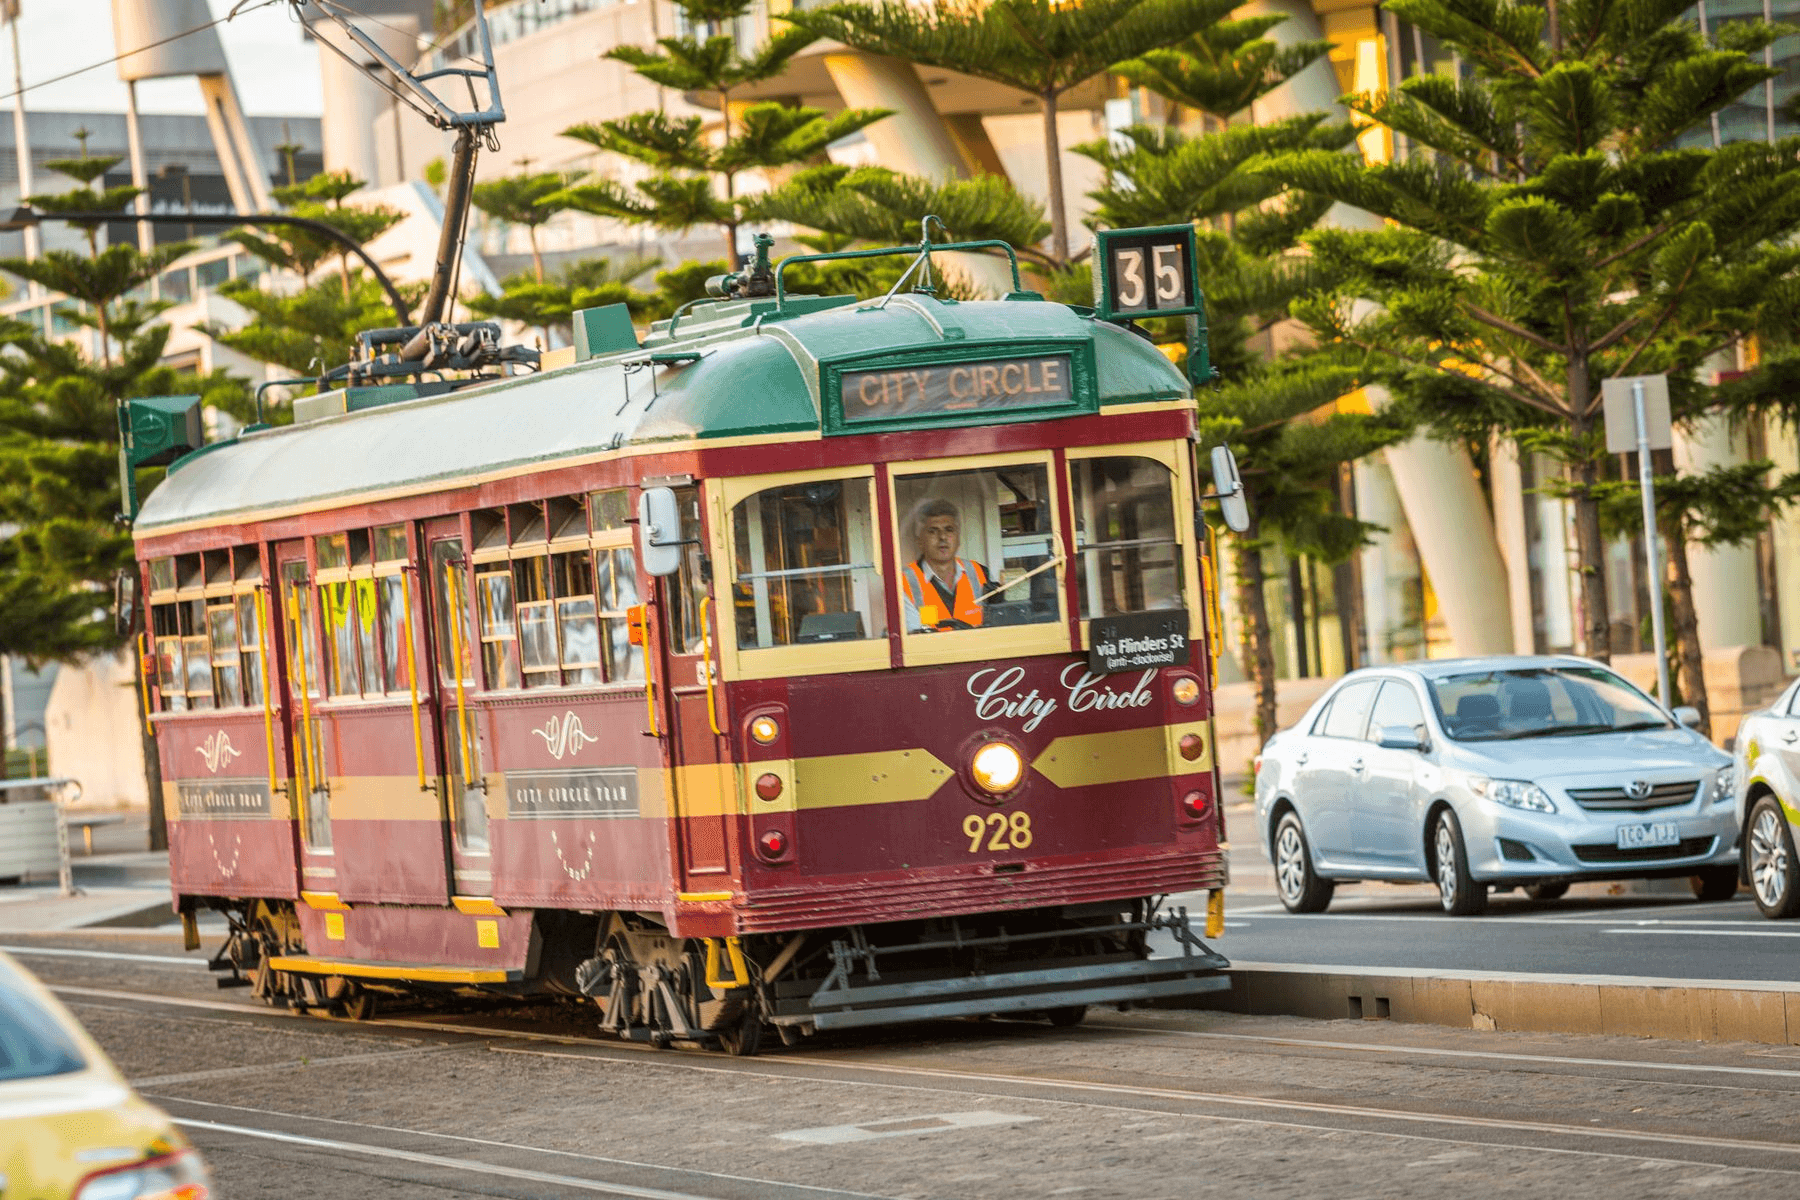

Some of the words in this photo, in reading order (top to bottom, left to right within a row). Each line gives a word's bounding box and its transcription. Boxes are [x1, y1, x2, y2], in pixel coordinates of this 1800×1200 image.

[1117, 243, 1181, 307] 35
[858, 369, 931, 407] CITY
[949, 360, 1063, 399] CIRCLE
[1096, 640, 1117, 657] via
[1118, 635, 1169, 654] Flinders
[1169, 633, 1185, 649] St
[1106, 650, 1175, 670] (anti-clockwise)
[966, 665, 1058, 733] City
[1059, 660, 1159, 713] Circle
[548, 786, 590, 803] CIRCLE
[962, 810, 1033, 853] 928
